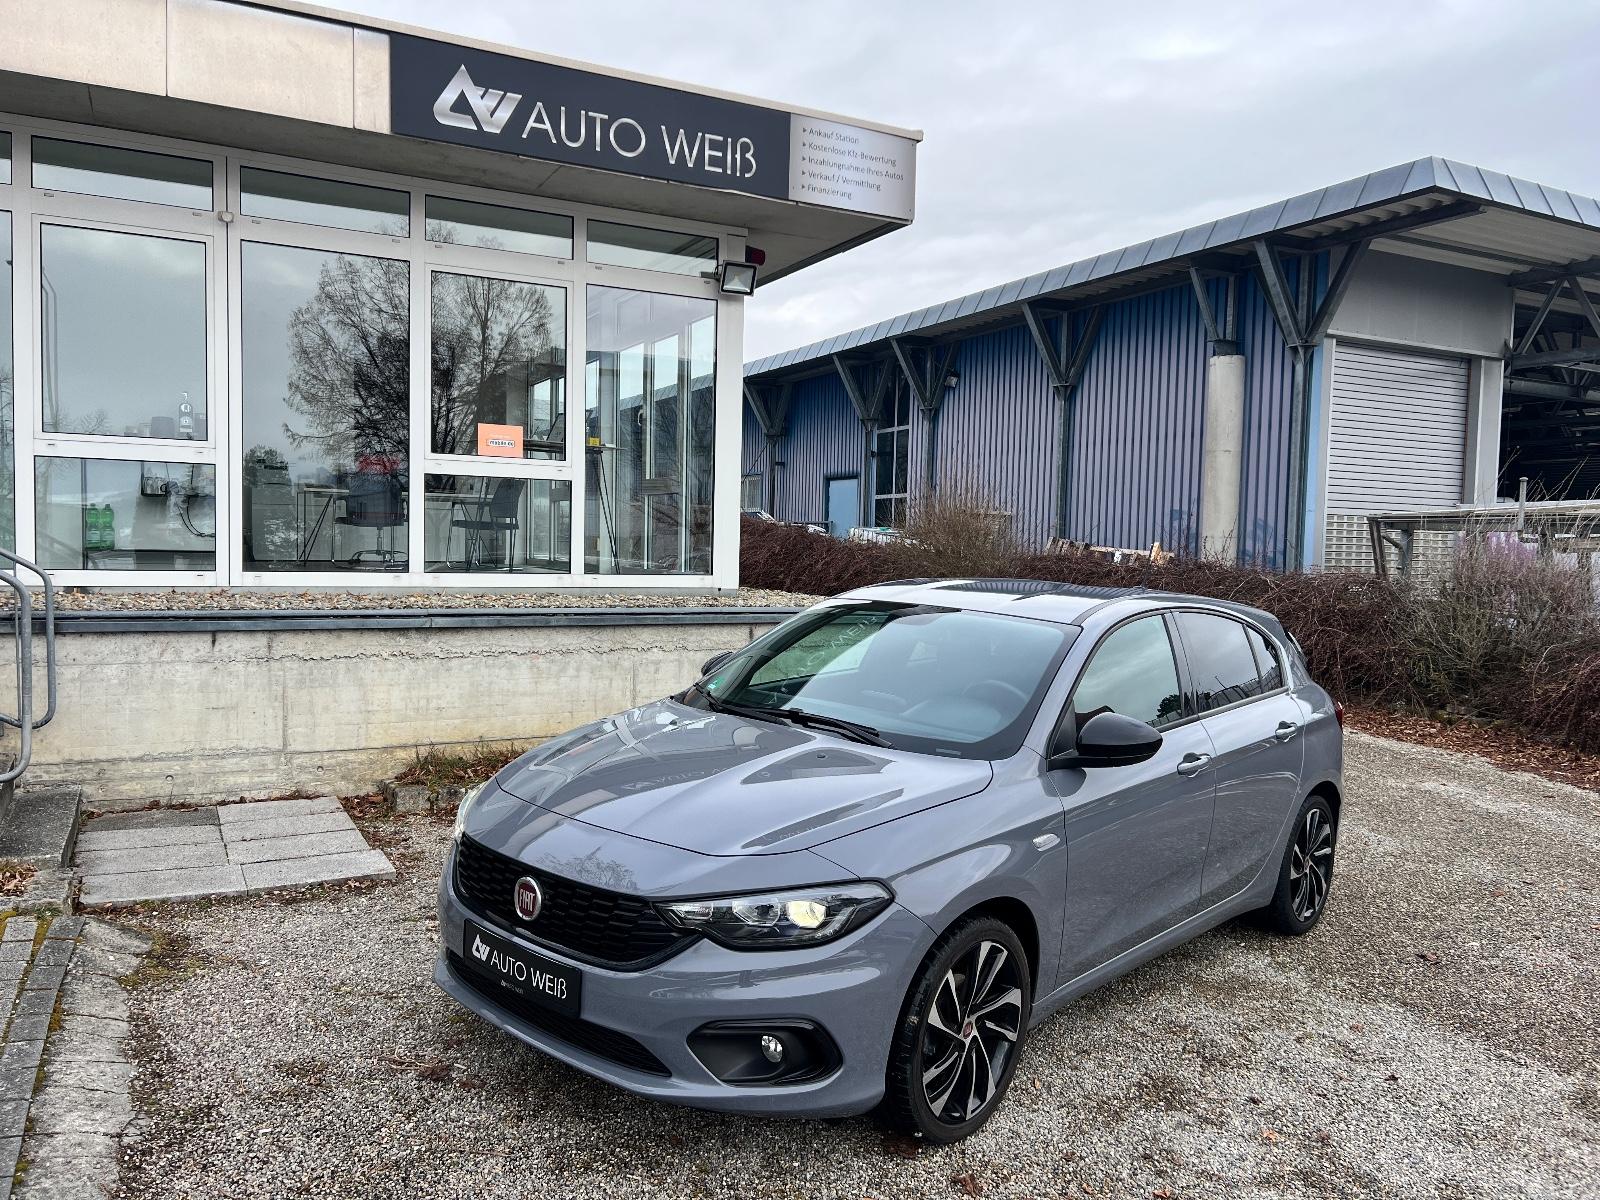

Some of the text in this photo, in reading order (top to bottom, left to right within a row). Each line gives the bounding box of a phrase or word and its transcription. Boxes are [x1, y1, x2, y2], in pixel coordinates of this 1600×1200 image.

[521, 101, 646, 158] AUTO
[661, 125, 757, 178] WEIß
[808, 127, 859, 144] Ankauf Station
[808, 142, 847, 155] Kostenlose
[808, 156, 904, 181] Inzahlungnahme Ihres Autos
[807, 183, 852, 200] Finanzierung
[808, 170, 835, 181] Verkauf
[842, 175, 881, 192] Vermittlung
[519, 888, 536, 912] FIAT
[490, 949, 527, 981] AUTO
[530, 967, 567, 999] WEIß
